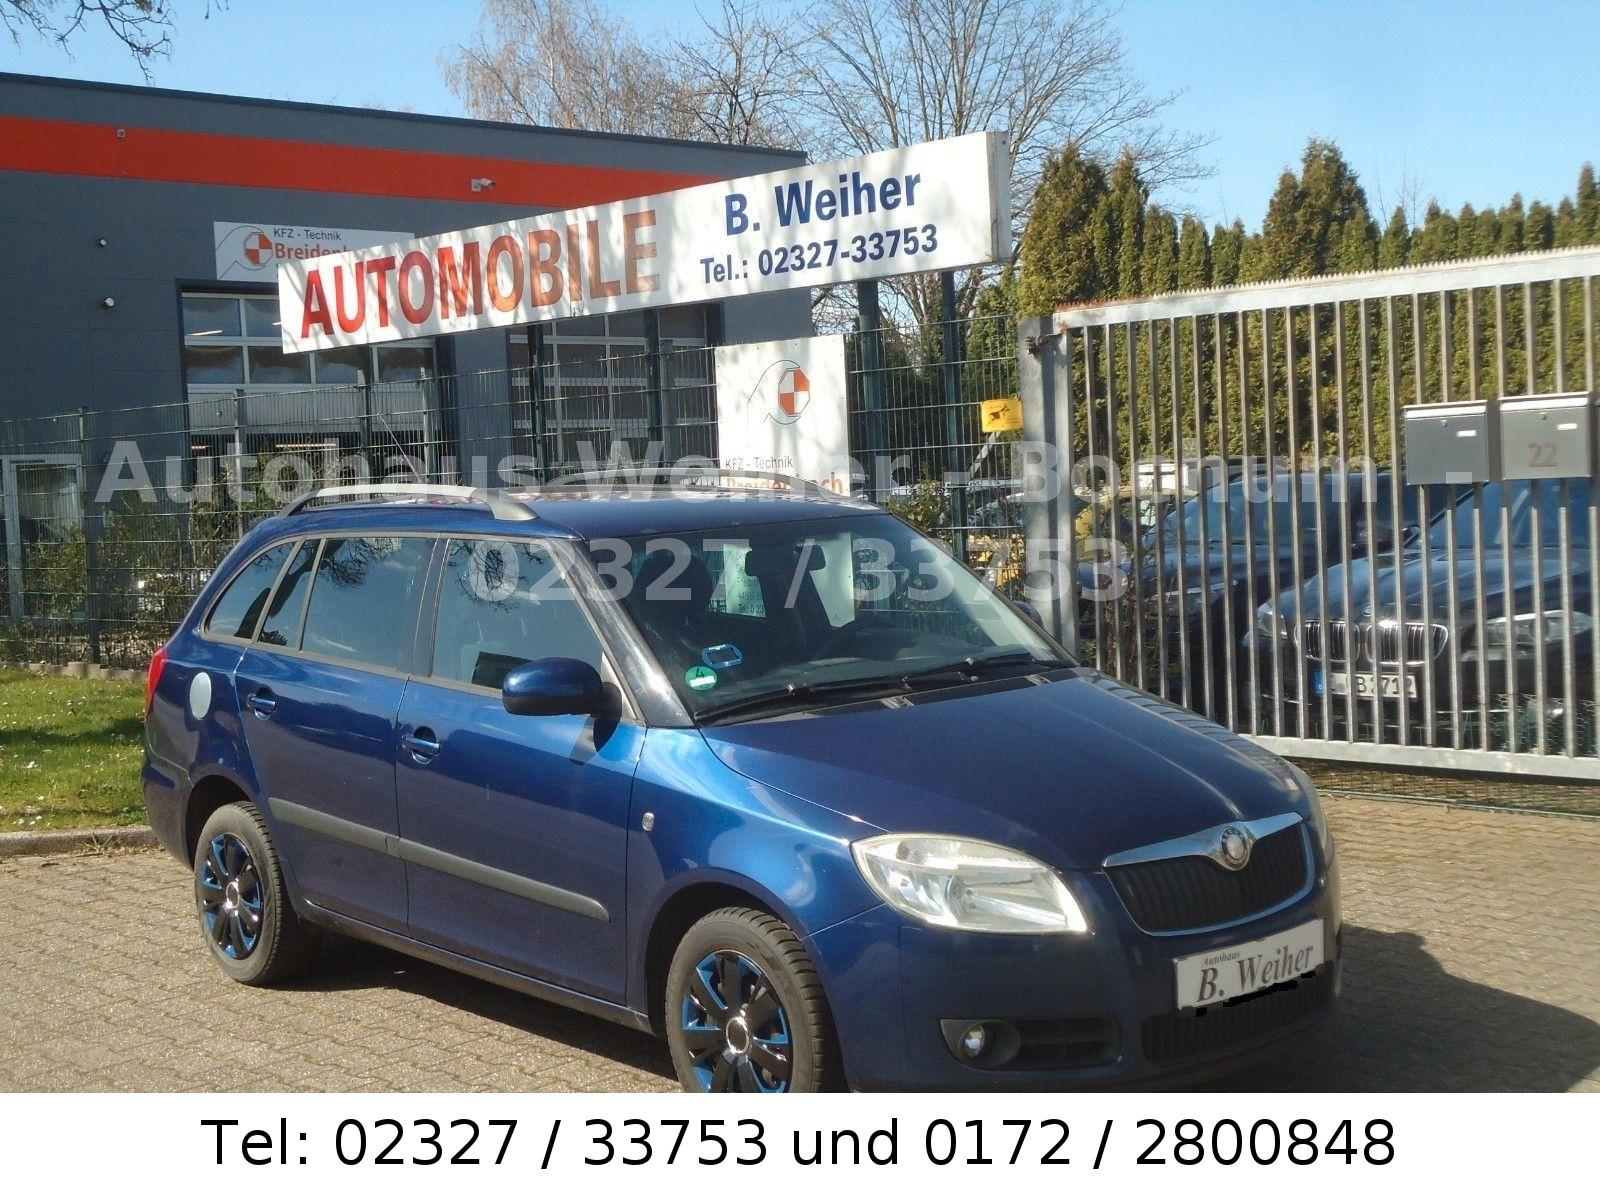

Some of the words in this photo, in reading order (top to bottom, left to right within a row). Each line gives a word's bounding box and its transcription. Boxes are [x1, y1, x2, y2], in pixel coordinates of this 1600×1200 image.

[725, 193, 760, 236] B.
[774, 171, 921, 228] Weiher
[273, 228, 295, 239] KFZ
[304, 229, 342, 241] Technik
[700, 255, 748, 284] Tel.:
[758, 223, 938, 276] 02327-33753
[301, 209, 660, 339] AUTOMOBILE
[725, 458, 744, 470] KFZ
[754, 456, 794, 470] Technik
[1527, 443, 1558, 468] 22
[1196, 967, 1225, 1002] B.
[1237, 945, 1314, 993] Weiher
[1202, 951, 1241, 966] Autohaus
